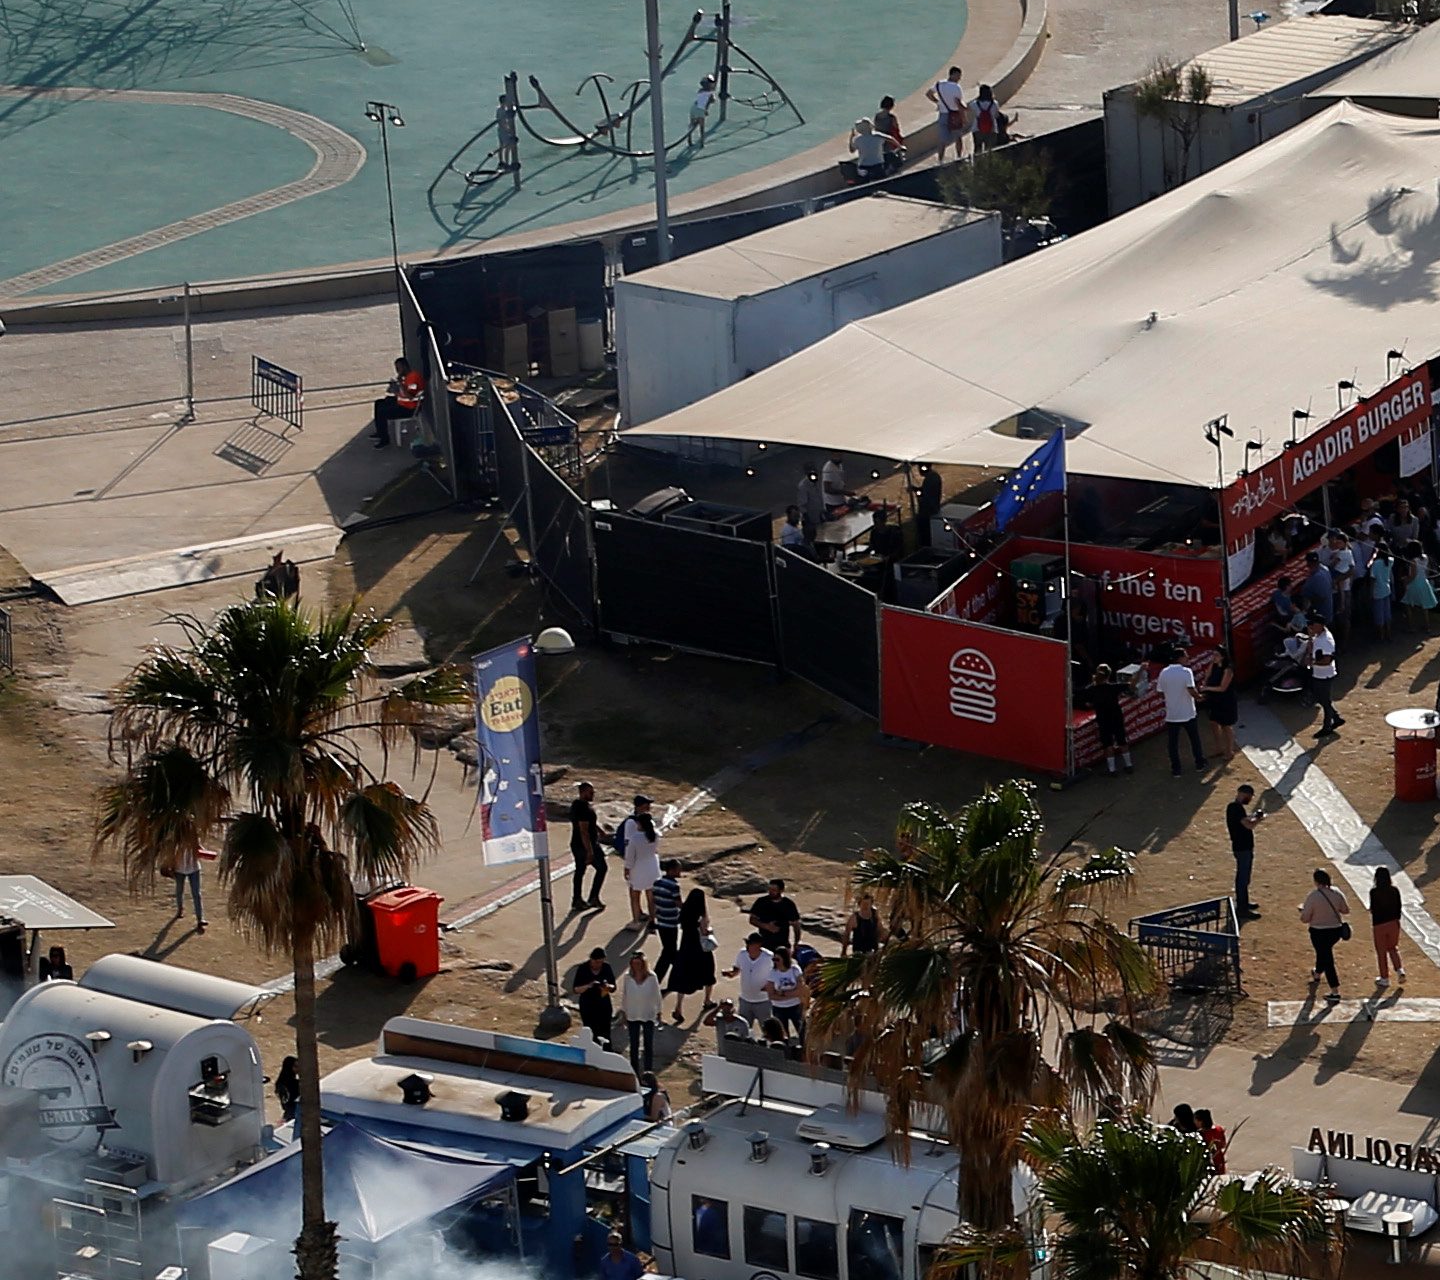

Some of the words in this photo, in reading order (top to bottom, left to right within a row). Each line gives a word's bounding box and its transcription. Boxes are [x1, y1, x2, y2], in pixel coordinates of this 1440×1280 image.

[1292, 425, 1354, 486] AGADIR
[1357, 380, 1425, 444] BURGER
[1119, 572, 1156, 598] the
[1163, 577, 1203, 604] ten
[1192, 616, 1215, 638] in
[490, 698, 523, 717] Eat
